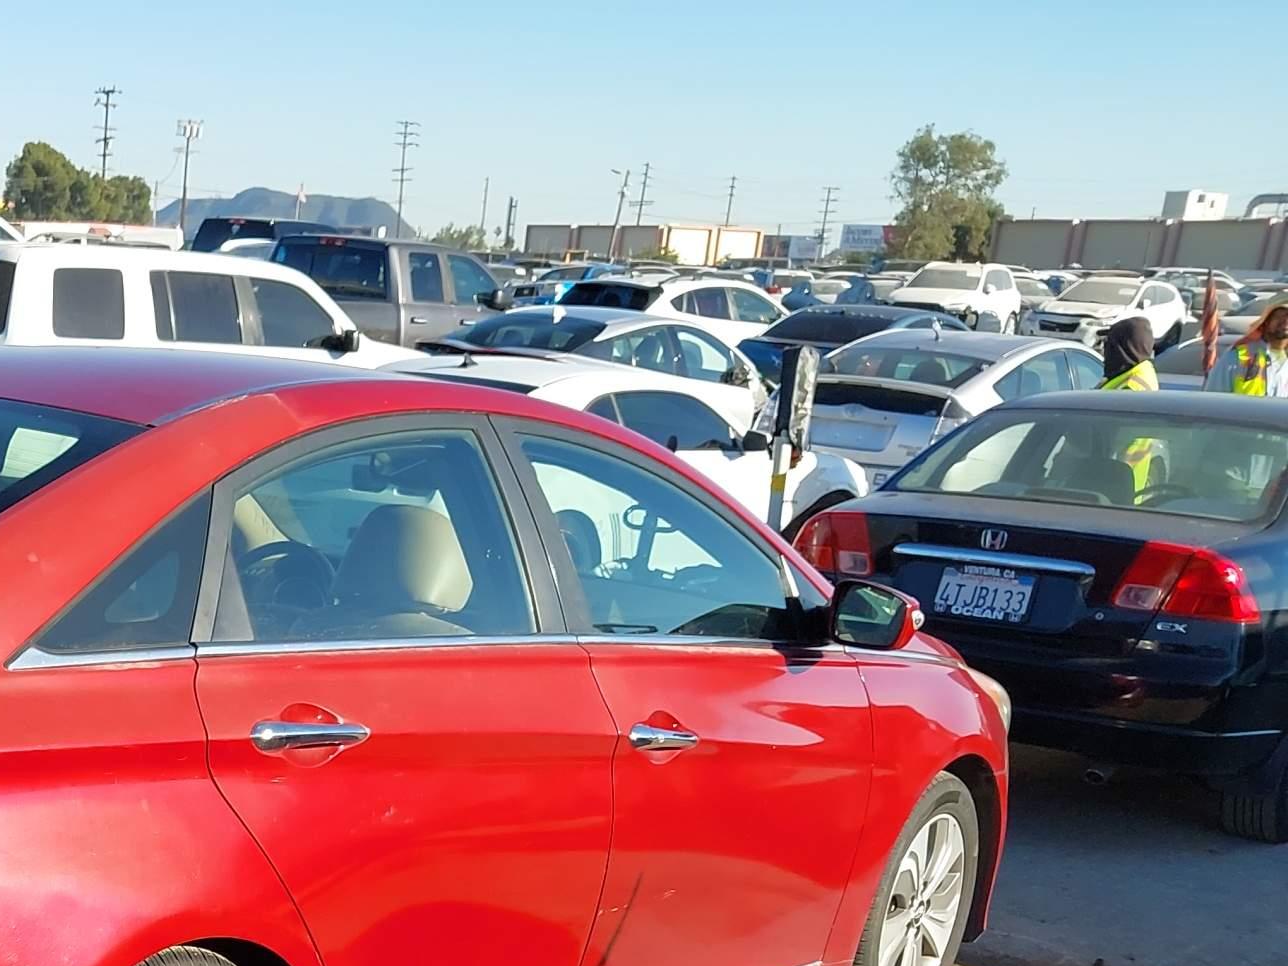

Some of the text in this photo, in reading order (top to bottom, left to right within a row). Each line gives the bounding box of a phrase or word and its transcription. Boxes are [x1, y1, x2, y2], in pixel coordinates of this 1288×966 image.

[939, 581, 1026, 613] 4TJB133
[950, 605, 1005, 620] OCEAN
[1156, 621, 1188, 634] EX
